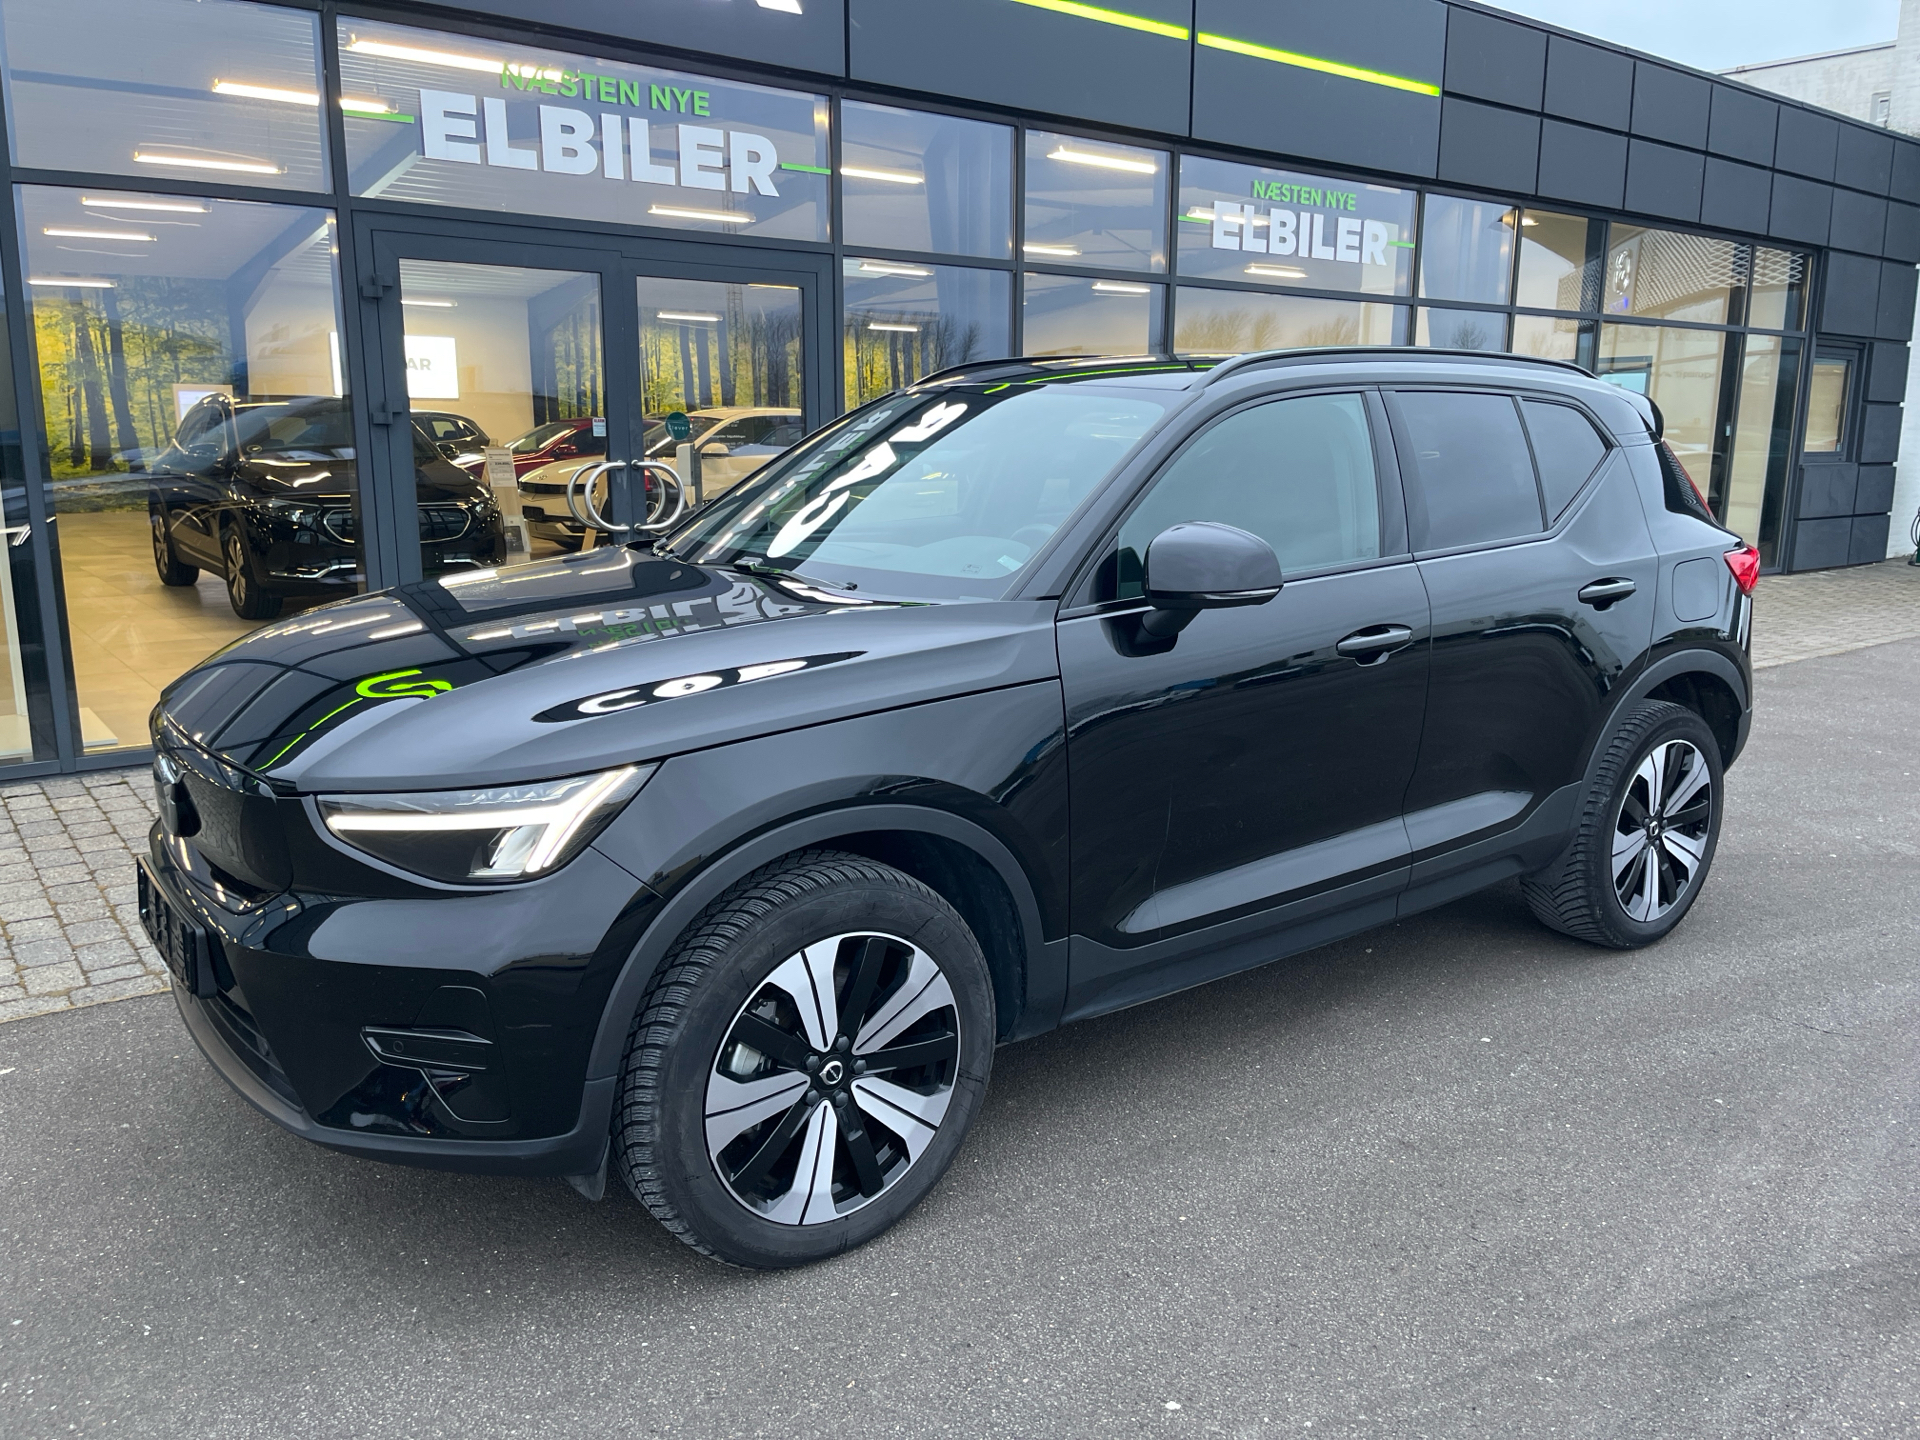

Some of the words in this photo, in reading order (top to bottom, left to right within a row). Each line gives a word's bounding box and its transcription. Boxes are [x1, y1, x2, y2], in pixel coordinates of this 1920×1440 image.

[500, 61, 640, 107] NÆSTEN
[651, 83, 711, 117] NYE
[420, 88, 780, 197] ELBILER
[1253, 179, 1321, 206] NÆSTEN
[1326, 190, 1357, 211] NYE
[1212, 200, 1388, 266] ELBILER
